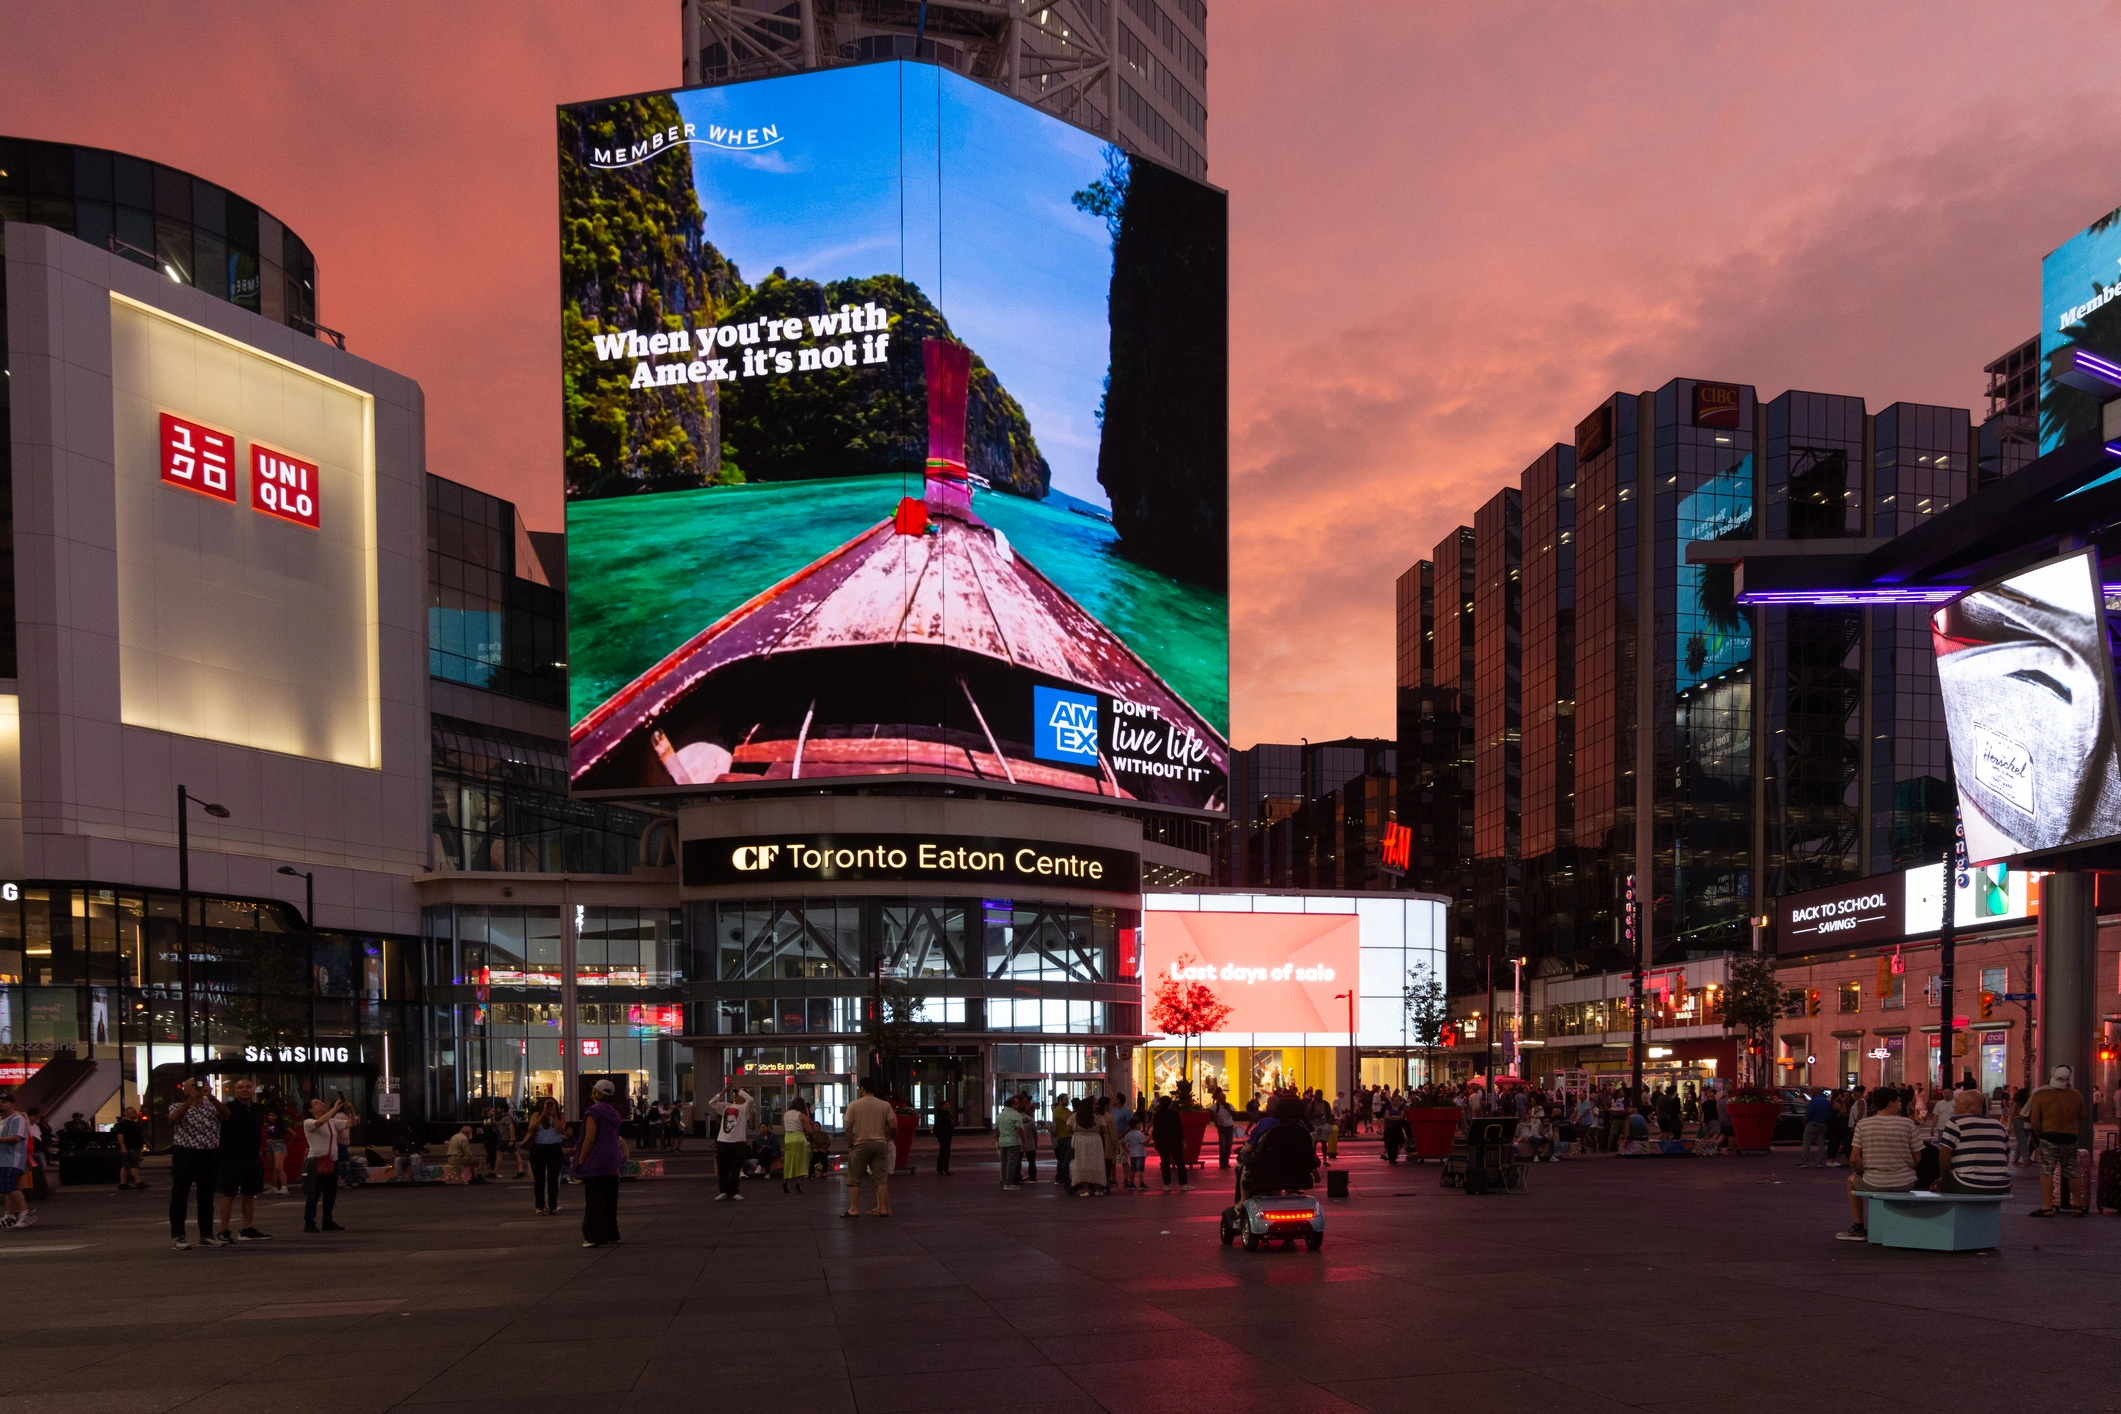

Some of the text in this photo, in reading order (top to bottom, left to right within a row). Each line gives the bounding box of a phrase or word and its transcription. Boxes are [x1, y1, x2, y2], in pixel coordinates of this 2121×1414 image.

[594, 122, 779, 164] MEMBER WHEN
[593, 302, 889, 362] When you're with
[630, 334, 889, 389] Amex, it's not if
[1700, 387, 1738, 405] CIBC
[1580, 411, 1602, 438] CIBC
[259, 454, 308, 491] UNI
[260, 482, 313, 517] QLO
[1112, 699, 1161, 721] DON'T
[1111, 717, 1209, 766] live life
[1112, 756, 1183, 780] WITHOUT
[1983, 741, 2027, 779] Herschel
[732, 844, 1104, 880] CF Toronto Eaton Centre
[1792, 893, 1887, 923] BACK TO SCHOOL
[1818, 917, 1857, 934] SAVINGS
[1171, 962, 1335, 984] Last days of sale
[43, 1041, 85, 1051] Serie
[245, 1045, 348, 1062] SAMSUNG
